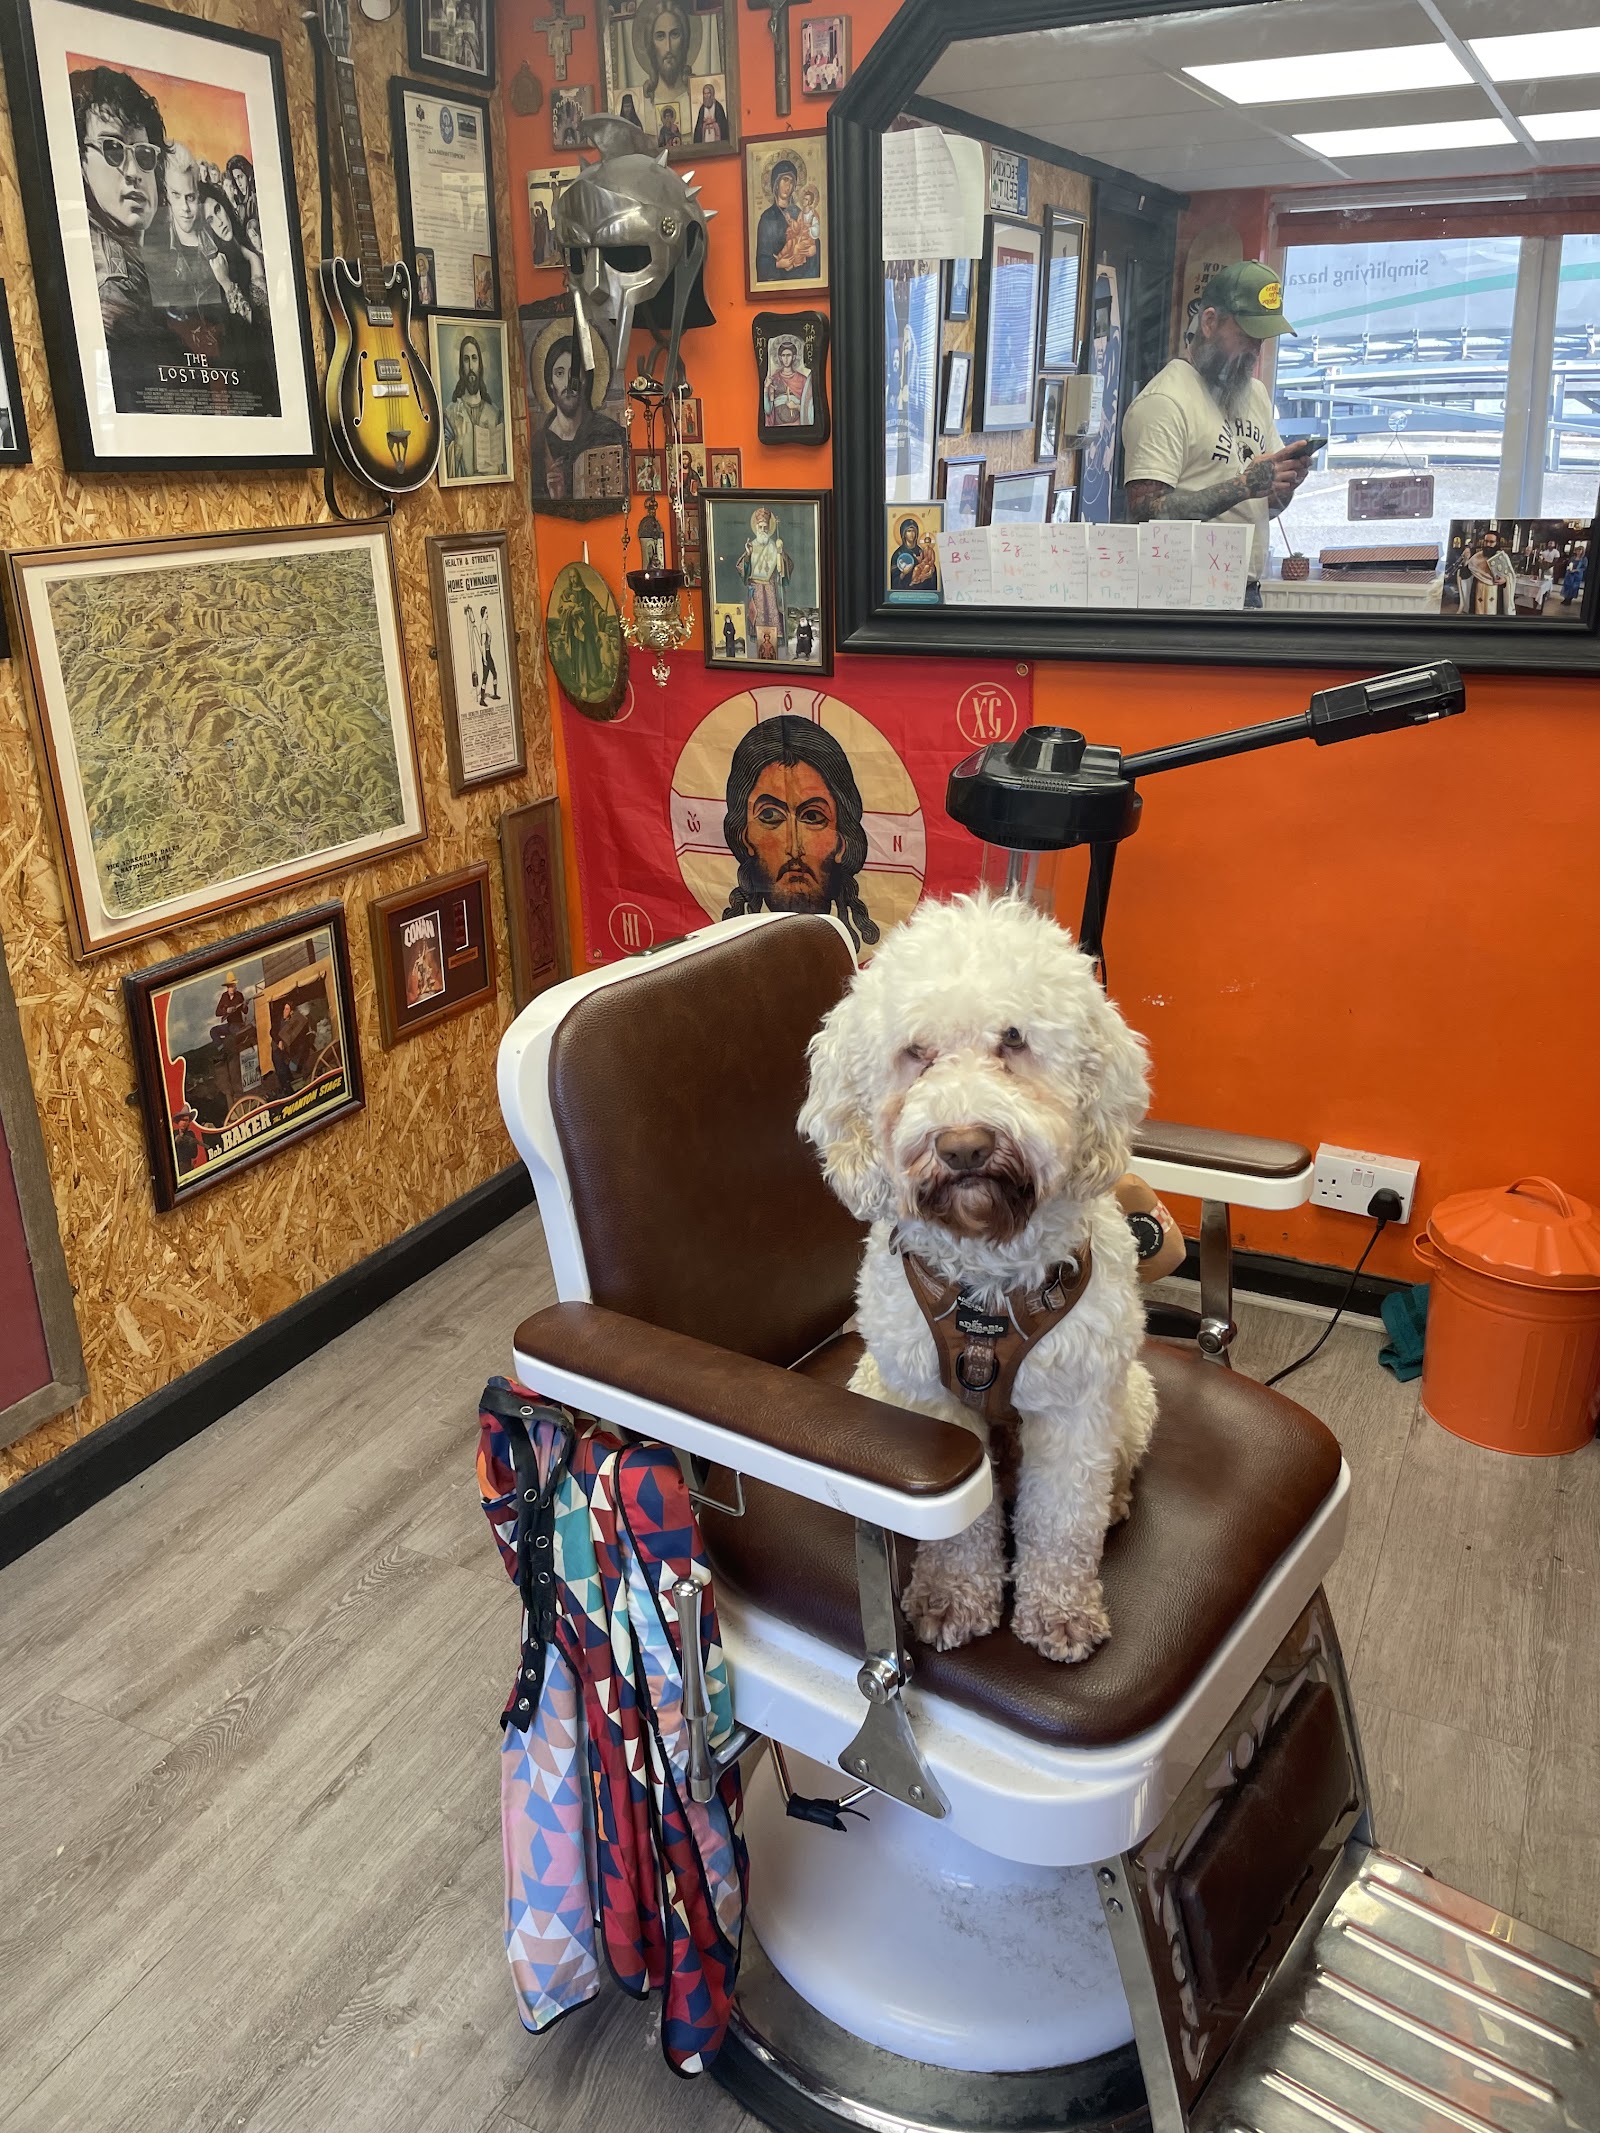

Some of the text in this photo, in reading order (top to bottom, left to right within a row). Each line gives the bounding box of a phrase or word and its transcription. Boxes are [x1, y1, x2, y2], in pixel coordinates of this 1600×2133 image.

[183, 352, 208, 367] THE
[158, 367, 240, 385] LOST BOYS
[445, 557, 463, 567] HEALTH
[465, 557, 469, 565] &
[447, 574, 497, 593] HOME GYMNASIUM
[106, 844, 180, 871] THE YORKSHIRE DALES
[120, 860, 151, 873] NATIONAL
[404, 918, 435, 948] CONAN
[208, 1144, 223, 1160] Bob
[221, 1110, 272, 1152] BAKER
[281, 1089, 318, 1119] PHANTOM
[319, 1076, 343, 1097] STAGE
